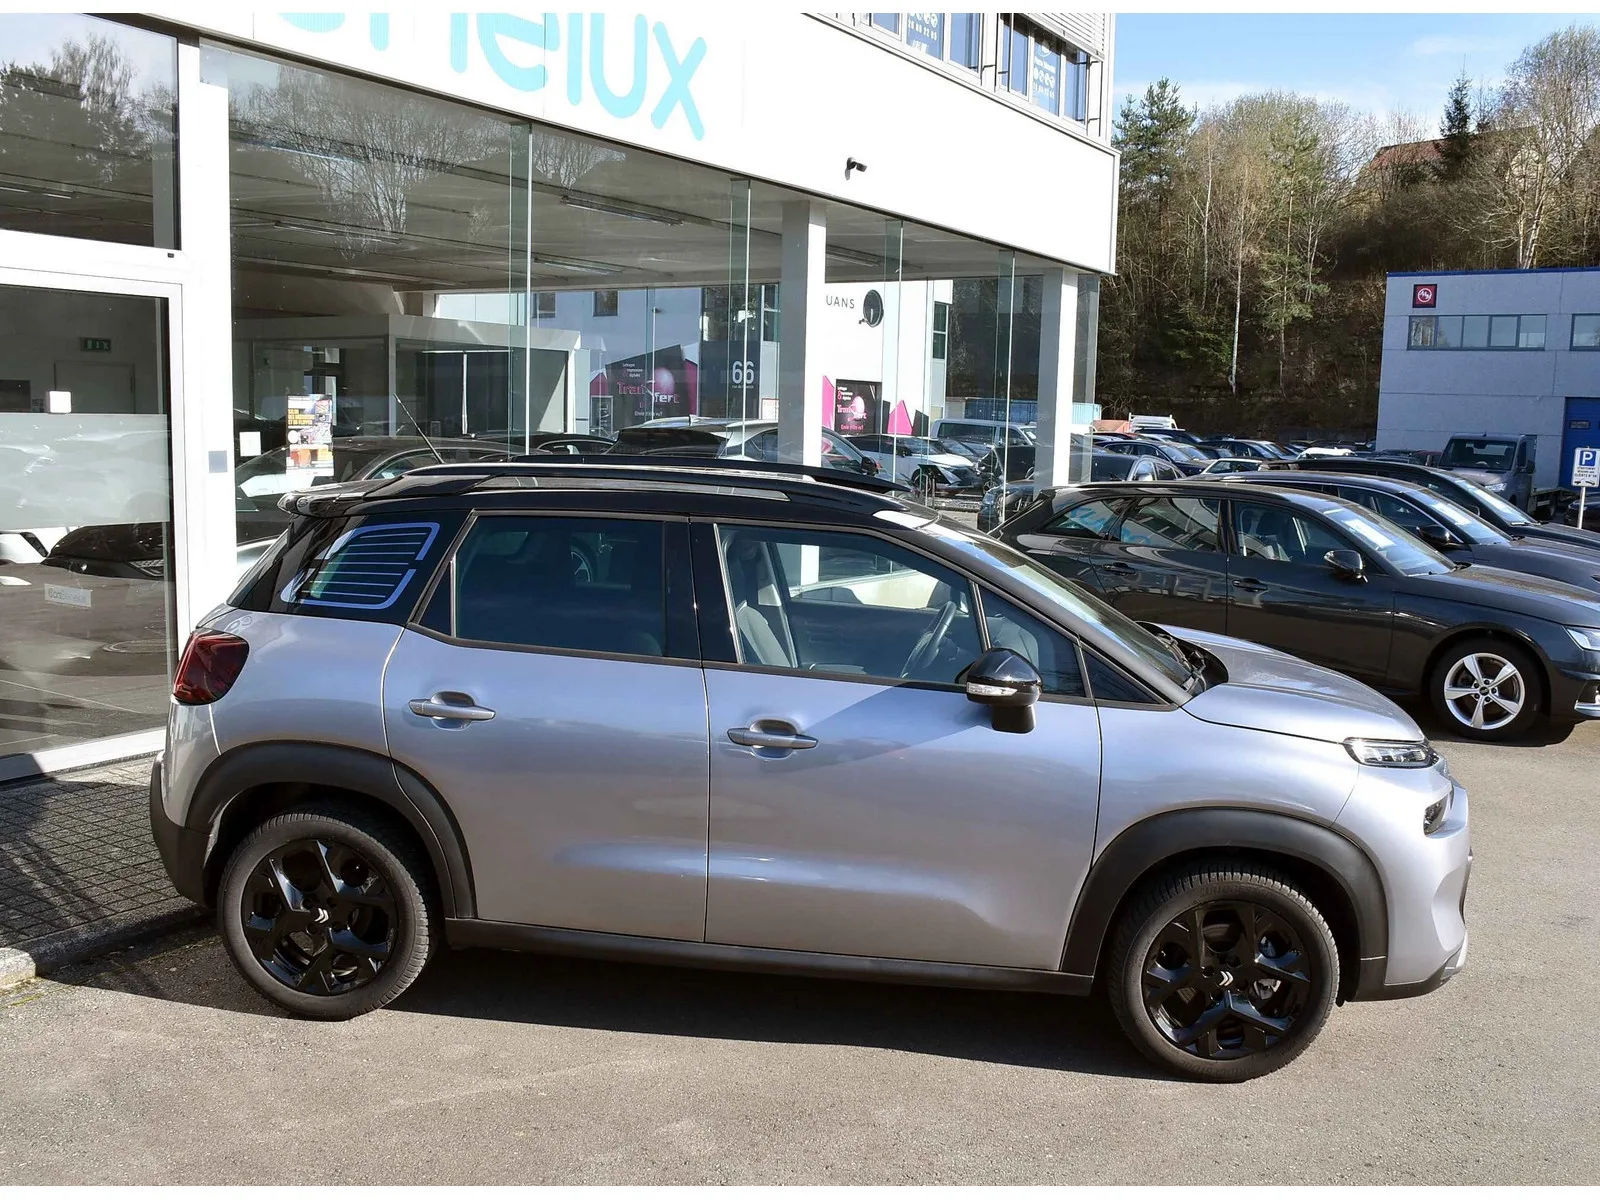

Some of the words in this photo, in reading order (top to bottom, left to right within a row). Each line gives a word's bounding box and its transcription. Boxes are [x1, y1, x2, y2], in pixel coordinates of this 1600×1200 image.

[277, 13, 707, 141] nelux
[732, 361, 754, 384] 66
[1581, 451, 1593, 465] P
